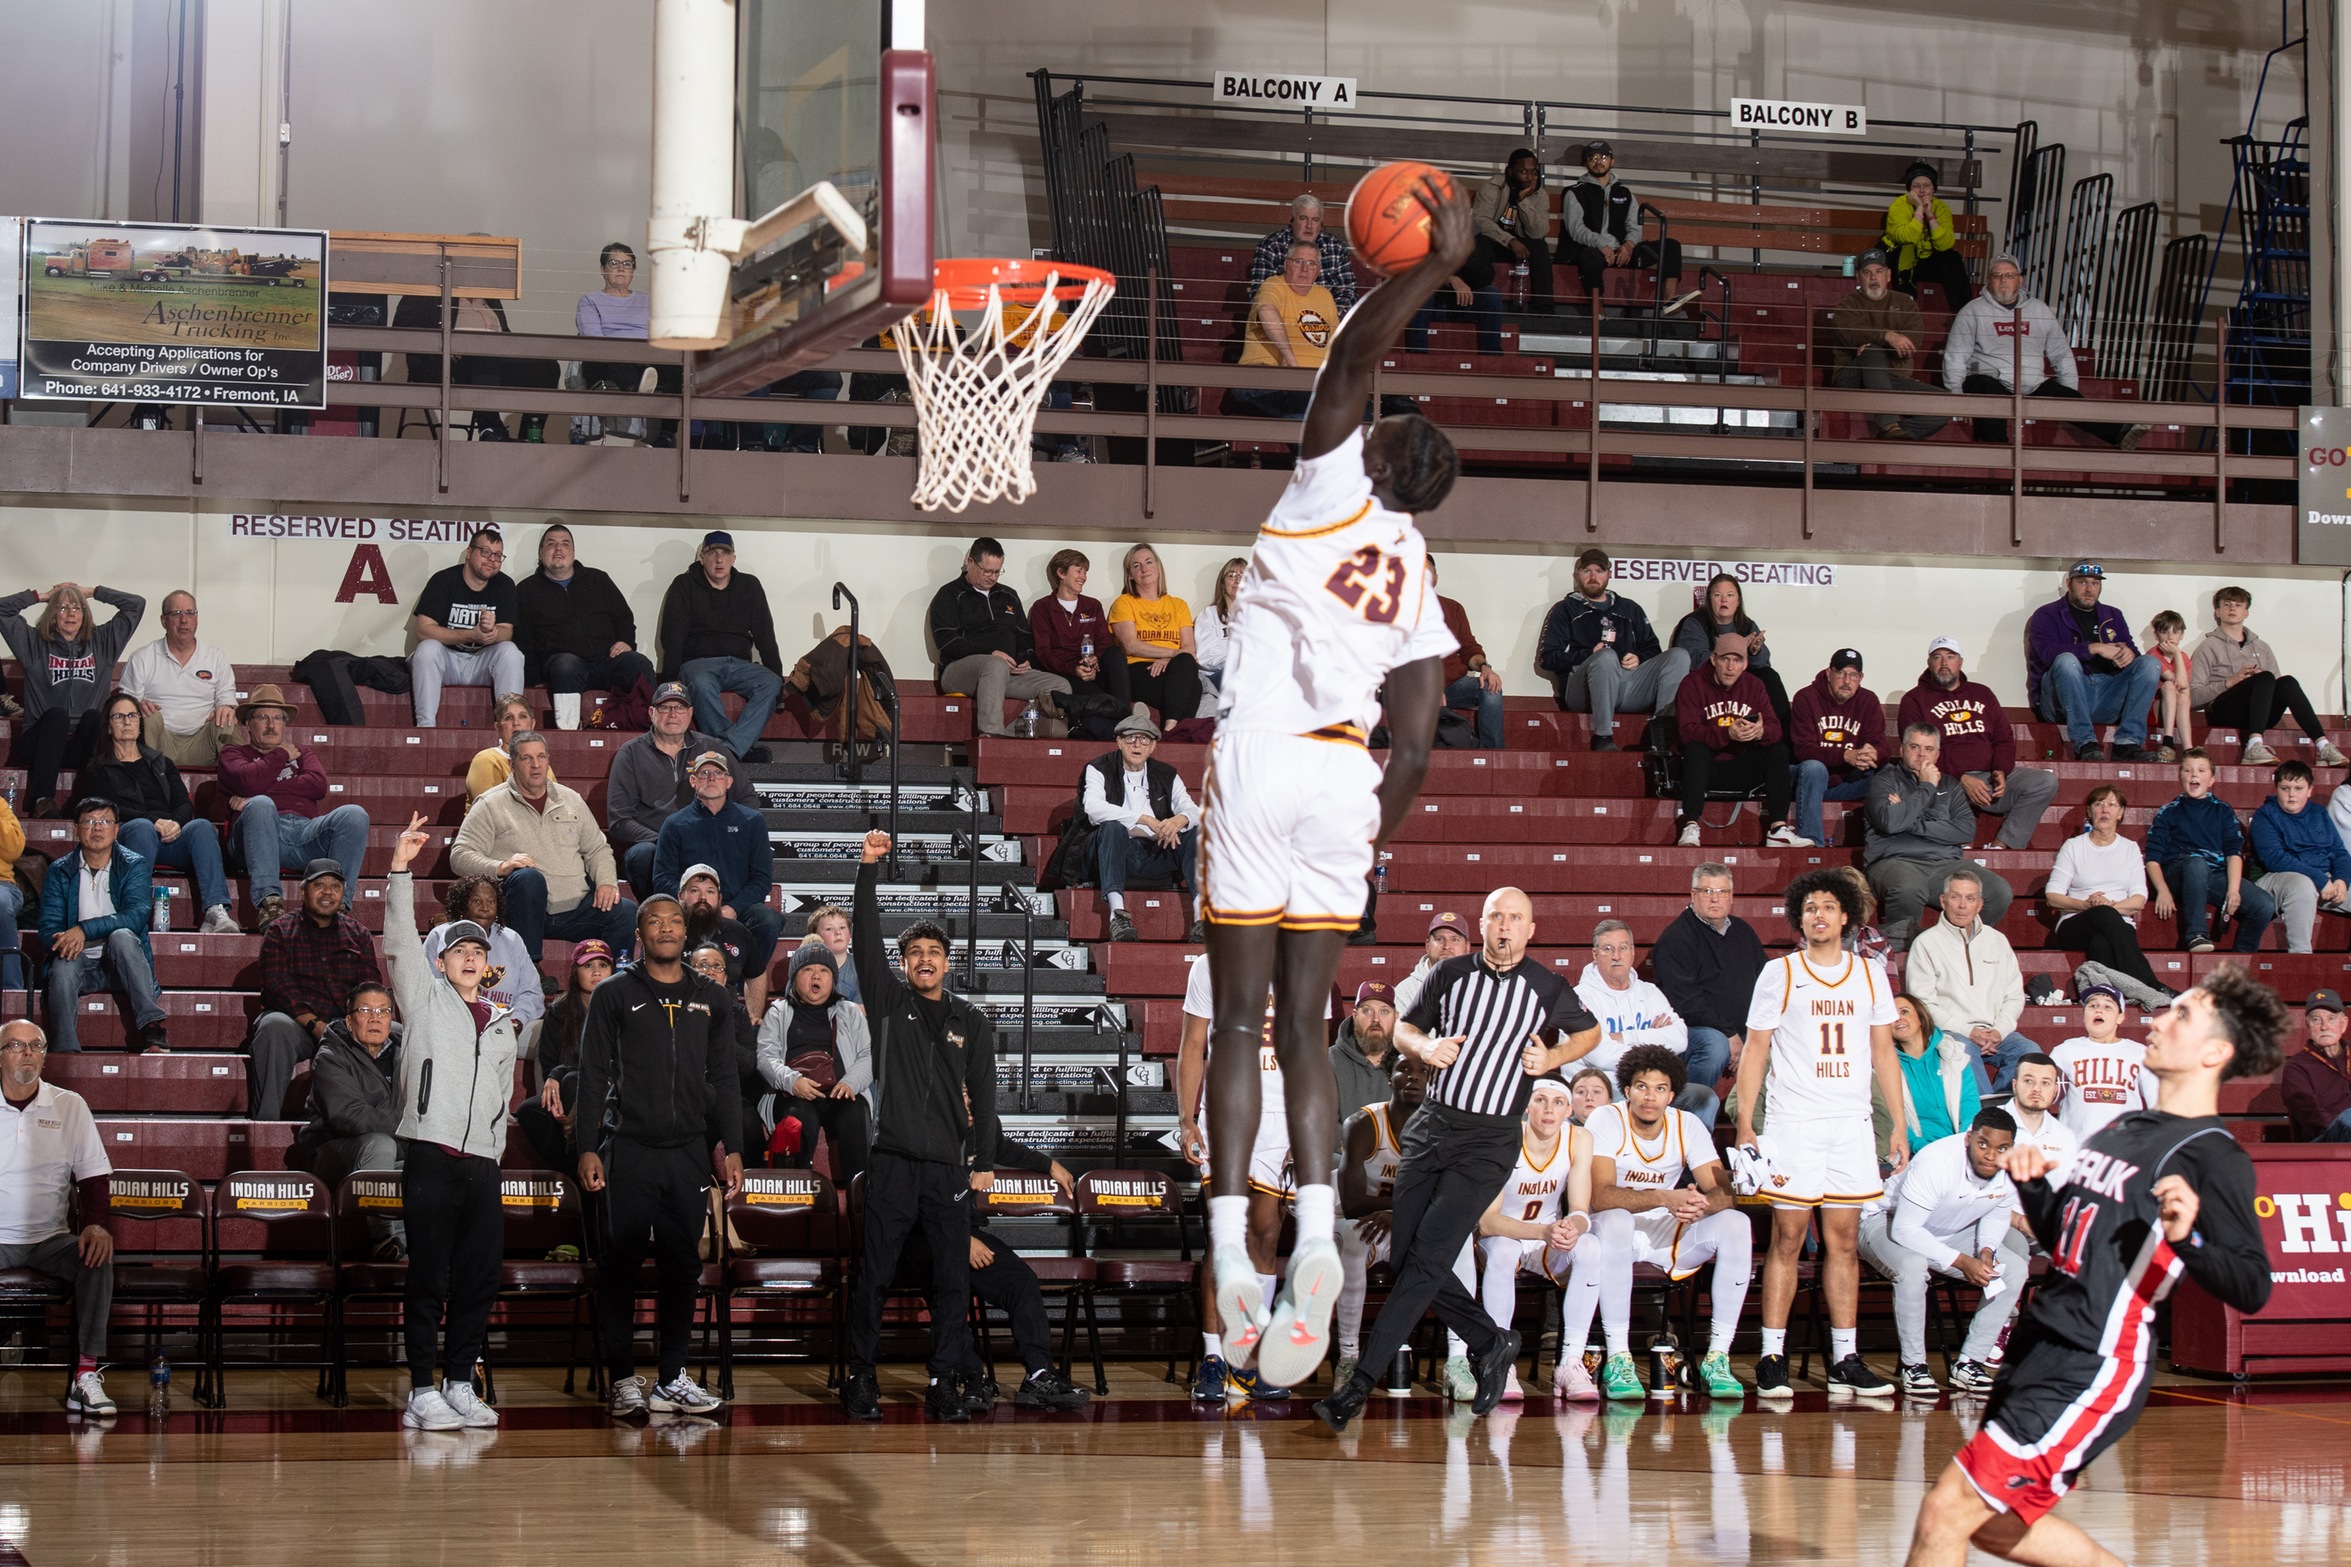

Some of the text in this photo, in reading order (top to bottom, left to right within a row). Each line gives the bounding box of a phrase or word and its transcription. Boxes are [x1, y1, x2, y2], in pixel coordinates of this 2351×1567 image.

[1223, 76, 1348, 102] BALCONY A
[1740, 104, 1858, 128] BALCONY B
[90, 282, 260, 298] Mike & Michelle Aschenbrenner
[142, 300, 313, 324] Aschenbrenner
[169, 321, 292, 343] Trucking Inc.
[86, 344, 264, 361] Accepting Applications for
[71, 358, 136, 375] Company
[140, 362, 188, 374] Drivers
[200, 364, 244, 376] Owner
[247, 365, 278, 380] Op's
[46, 380, 299, 404] Phone: 641-933-4172 Fremont, IA
[232, 514, 376, 539] RESERVED
[334, 544, 399, 604] A
[1608, 560, 1832, 585] ESERVED SEATING
[1324, 543, 1406, 624] 23
[1136, 630, 1162, 641] NDIAN
[49, 653, 96, 670] INDIAN
[52, 668, 95, 686] HILLS
[1704, 700, 1752, 720] INDIAN
[1930, 700, 1986, 718] INDIAN
[1944, 720, 1985, 736] HILLS
[768, 792, 795, 800] group
[796, 792, 806, 800] of
[837, 792, 880, 800] dedicated
[897, 794, 928, 802] ulfilling
[793, 842, 819, 850] group
[820, 842, 830, 850] of
[920, 843, 951, 852] fulfillin
[490, 992, 512, 1004] HILLS
[1812, 1000, 1854, 1016] INDIAN
[1820, 1022, 1845, 1054] 11
[1054, 1066, 1094, 1074] fulfilling
[1816, 1062, 1850, 1078] HILLS
[2073, 1058, 2140, 1092] HILLS
[2086, 1091, 2098, 1100] EST.
[1624, 1170, 1666, 1184] INDIAN
[110, 1180, 189, 1197] NDIAN HILLS
[230, 1182, 314, 1198] INDIAN HILLS
[352, 1180, 396, 1197] INDIAN
[530, 1180, 564, 1196] HILLS
[786, 1179, 822, 1194] HILLS
[1024, 1178, 1059, 1194] HILLS
[1090, 1178, 1166, 1196] INDIAN HILLS
[1518, 1179, 1558, 1196] INDIAN
[1522, 1200, 1543, 1221] 0
[2052, 1196, 2099, 1278] 11
[2270, 1268, 2345, 1284] wnload
